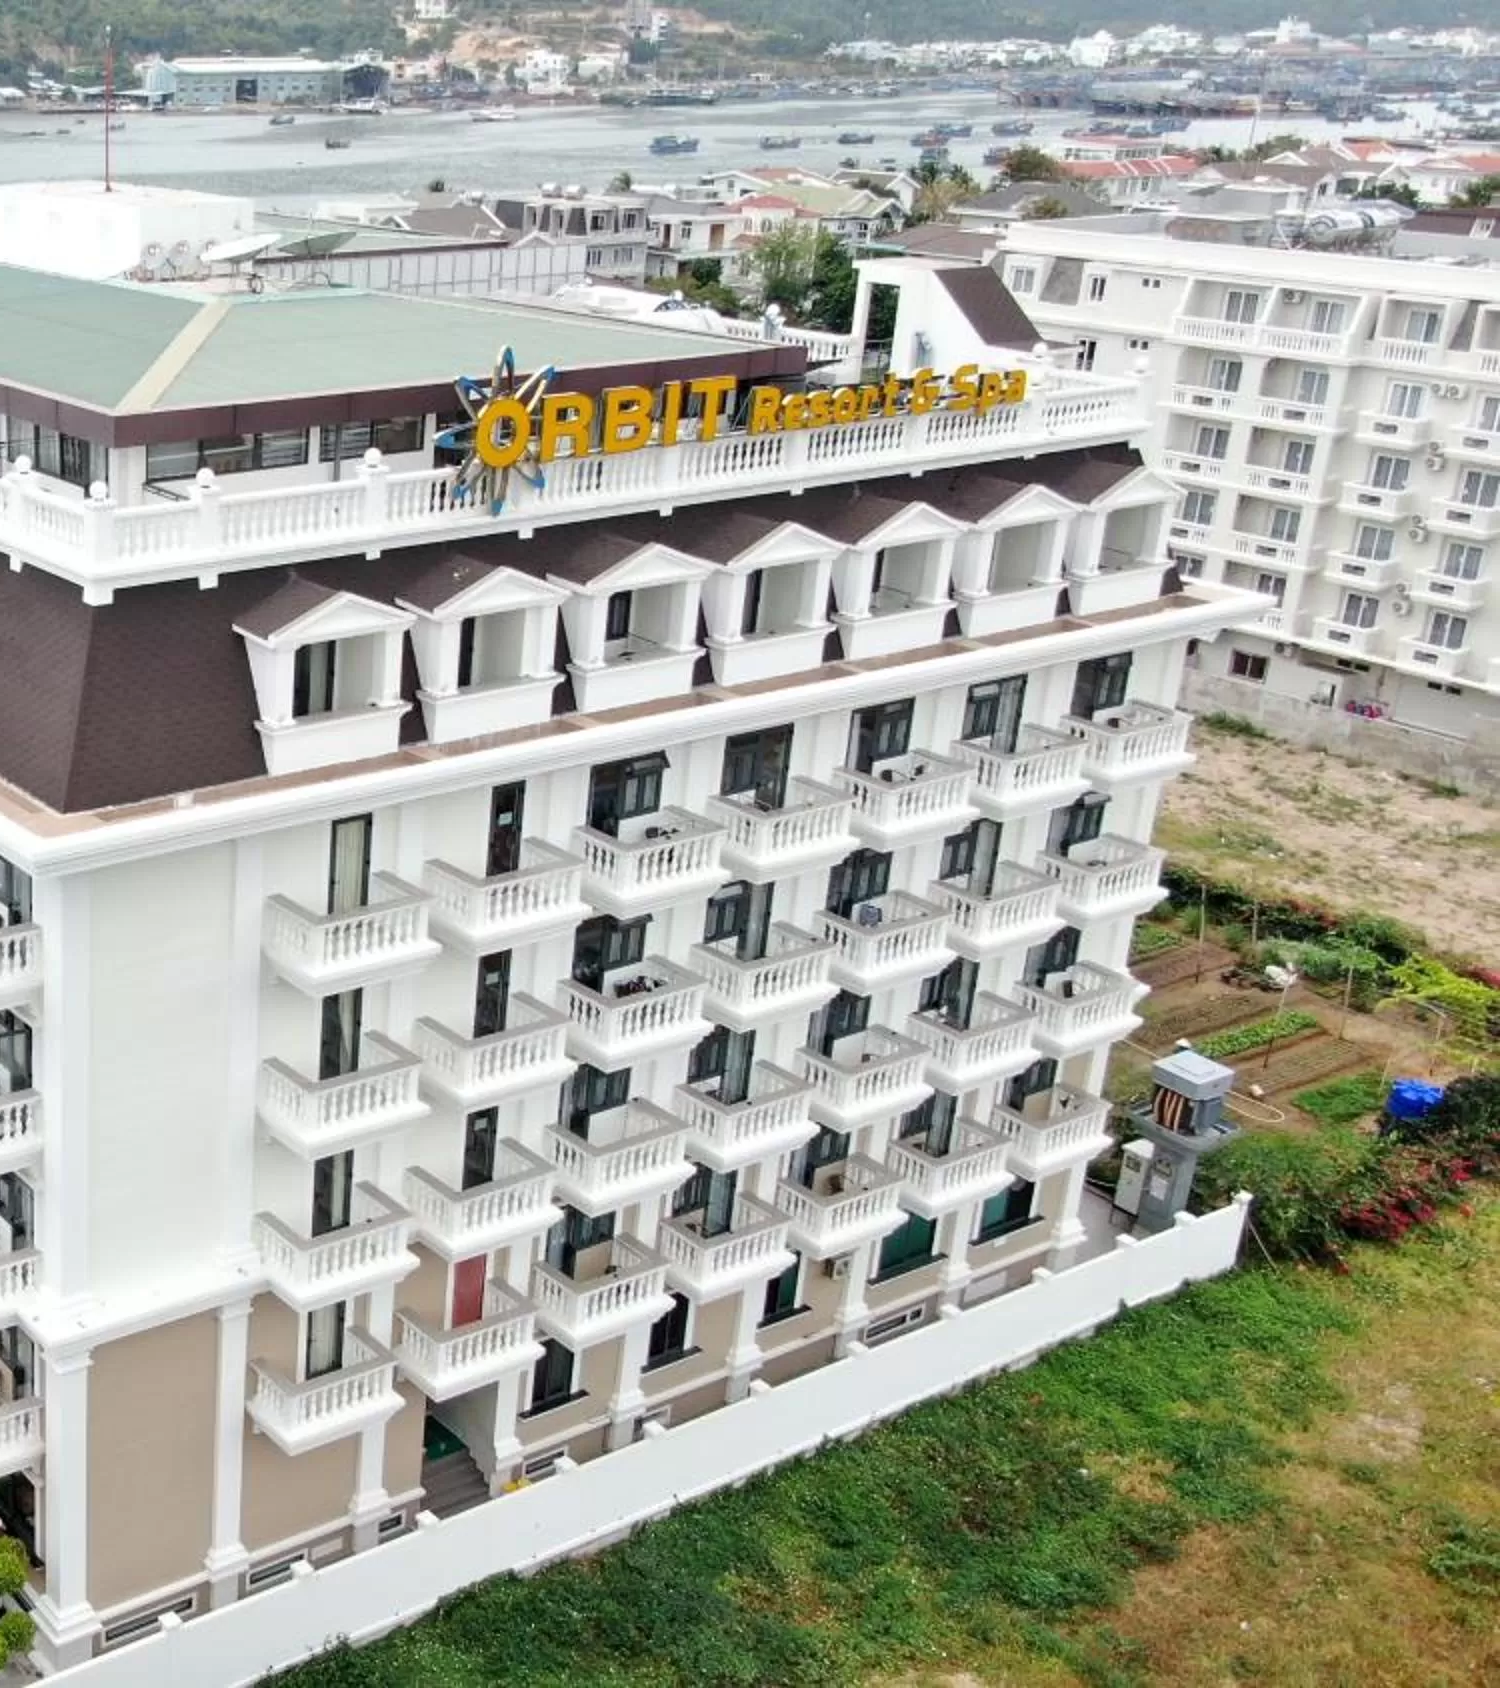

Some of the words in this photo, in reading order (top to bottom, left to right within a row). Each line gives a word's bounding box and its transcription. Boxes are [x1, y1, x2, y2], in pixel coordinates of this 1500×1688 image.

[475, 375, 738, 469] ORBIT
[741, 371, 901, 435] Resort
[908, 367, 941, 416] &
[946, 363, 1027, 417] Spa
